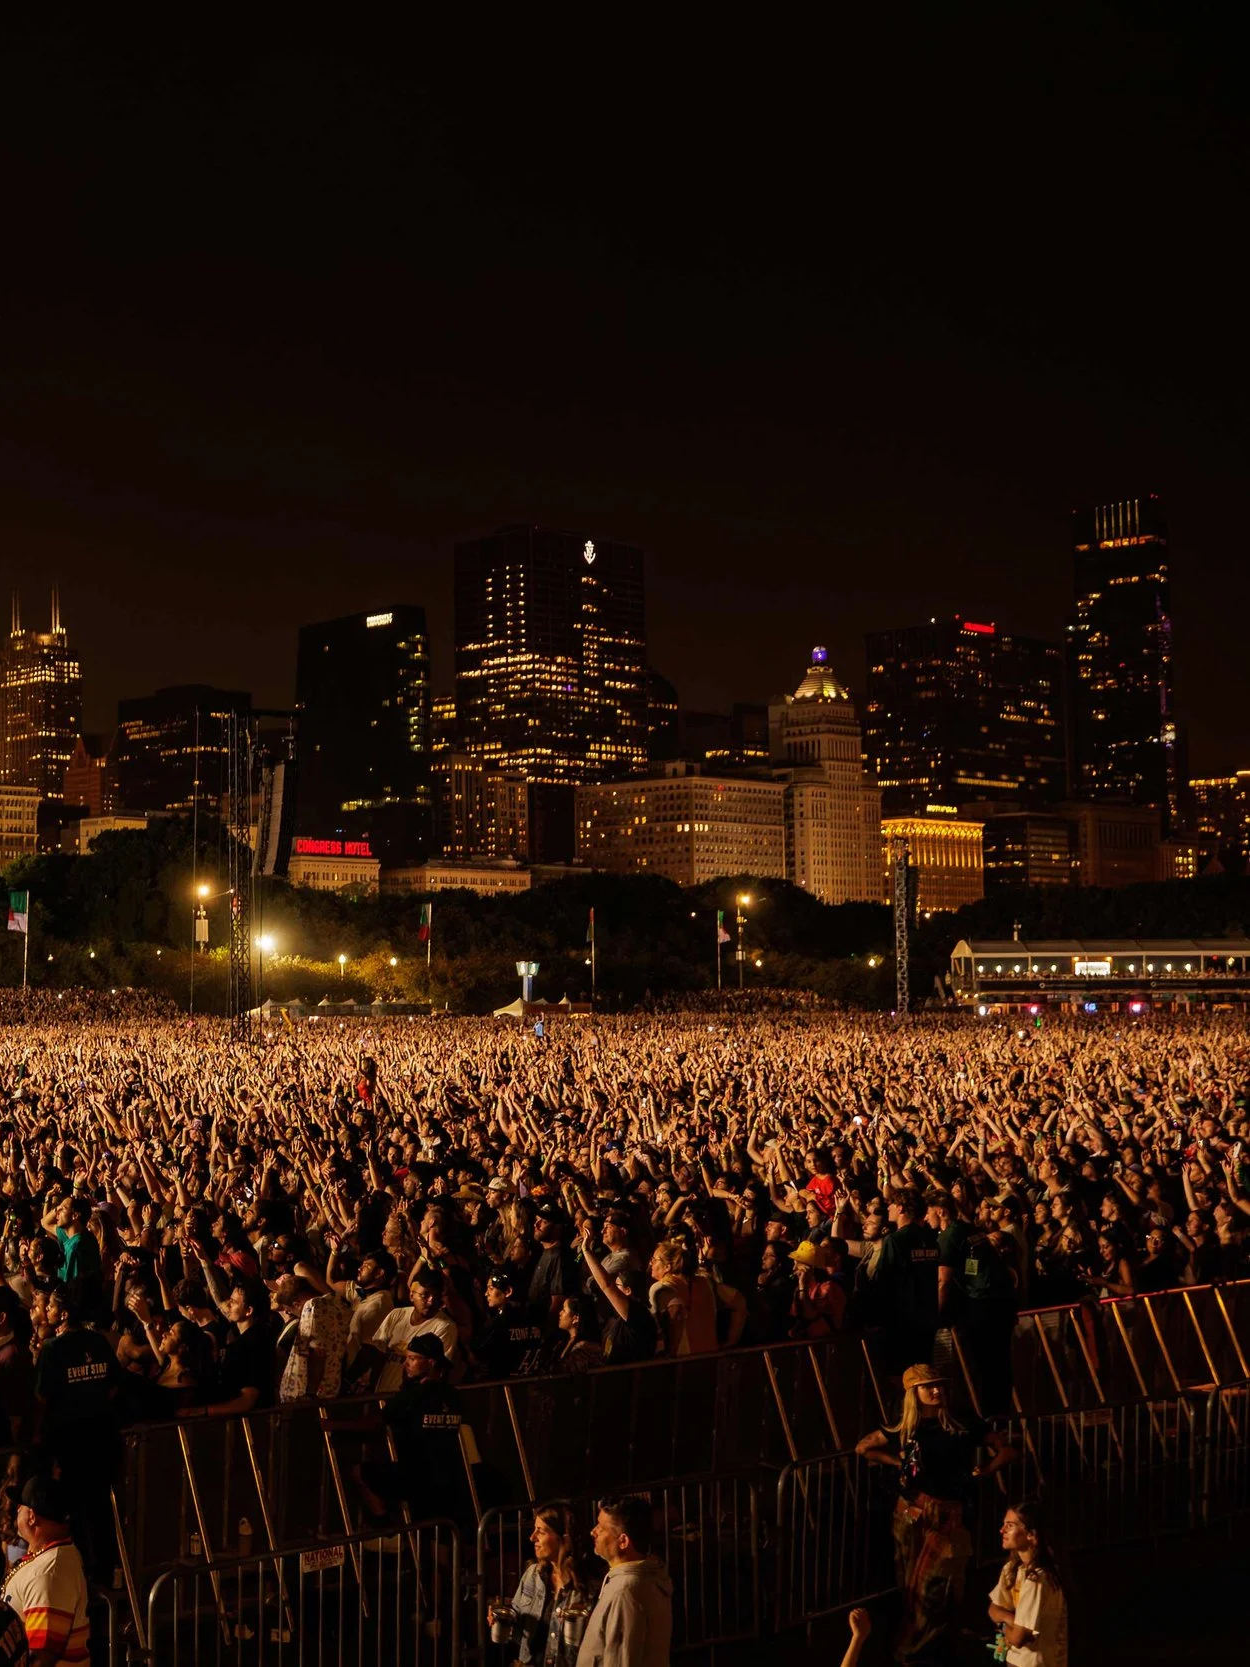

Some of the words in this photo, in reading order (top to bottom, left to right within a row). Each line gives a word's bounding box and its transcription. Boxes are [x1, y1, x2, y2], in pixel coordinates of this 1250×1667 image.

[296, 838, 342, 855] CONGRESS
[344, 840, 372, 857] HOTEL
[67, 1365, 89, 1379] EVENT
[303, 1545, 344, 1563] NATIONAL
